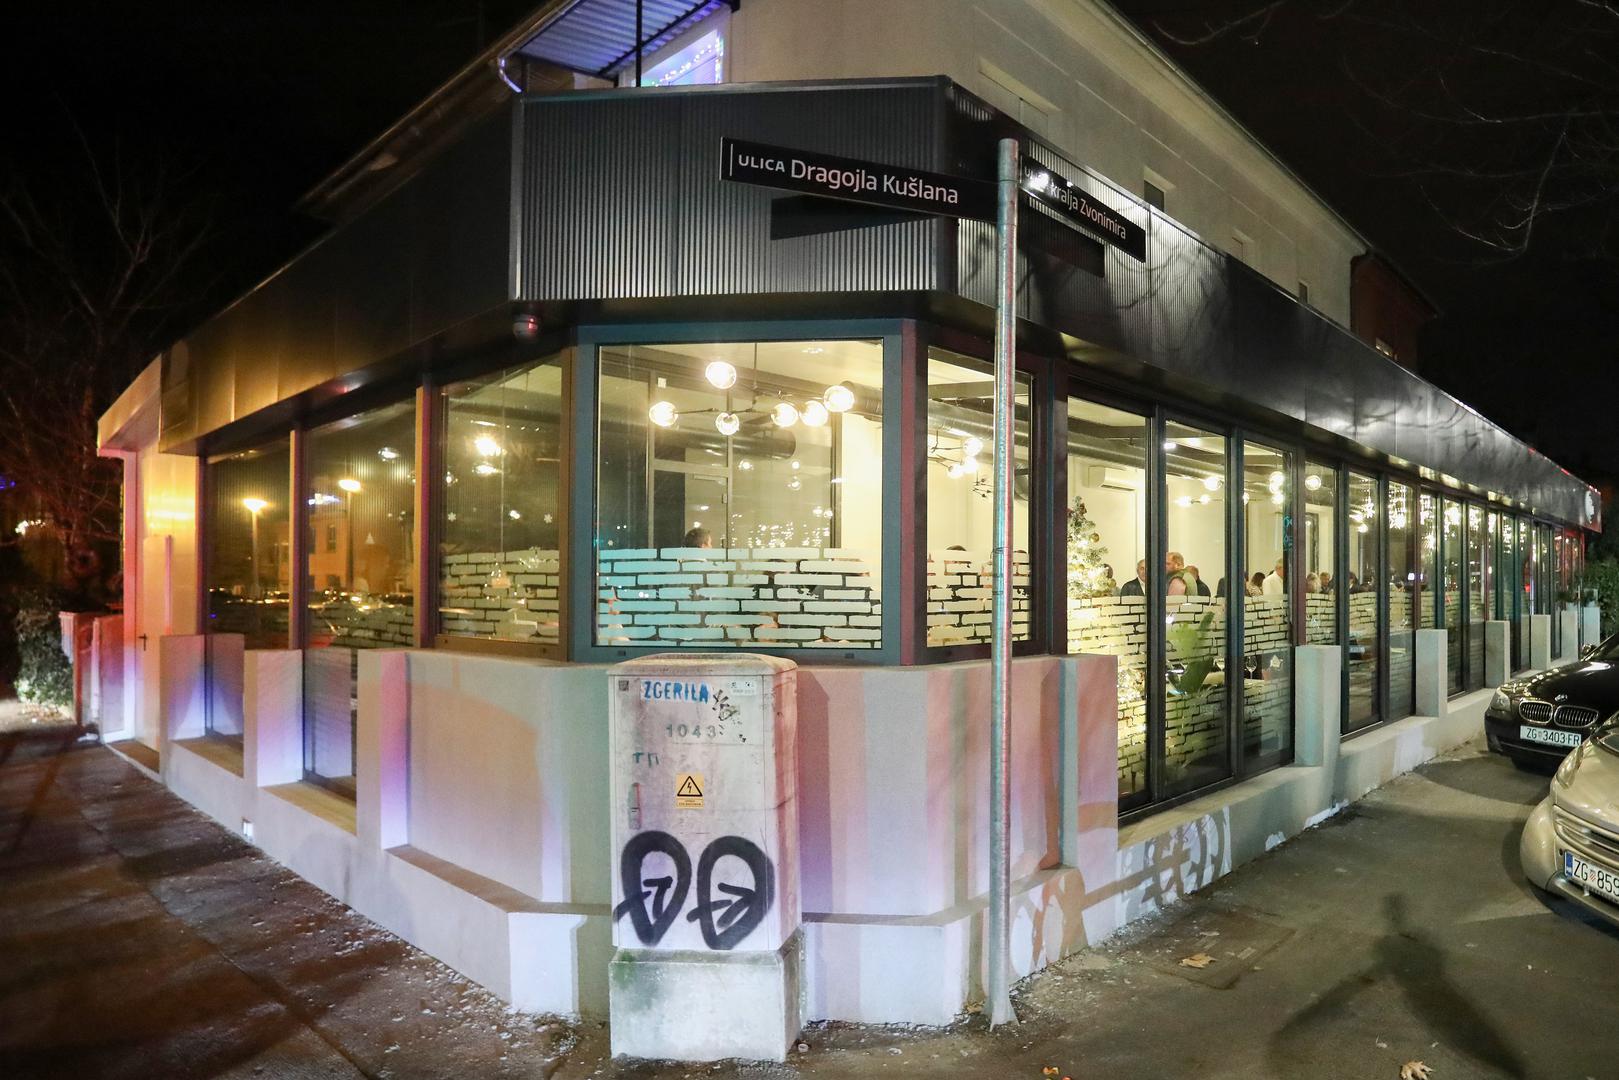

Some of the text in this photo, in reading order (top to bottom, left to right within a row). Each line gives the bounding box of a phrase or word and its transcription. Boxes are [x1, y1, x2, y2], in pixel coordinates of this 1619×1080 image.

[738, 154, 958, 203] ULICA Dragojla Kušlana
[1080, 198, 1126, 239] Zvonimira
[666, 724, 716, 738] 1043
[1526, 727, 1537, 739] ZG
[1574, 859, 1588, 881] ZG
